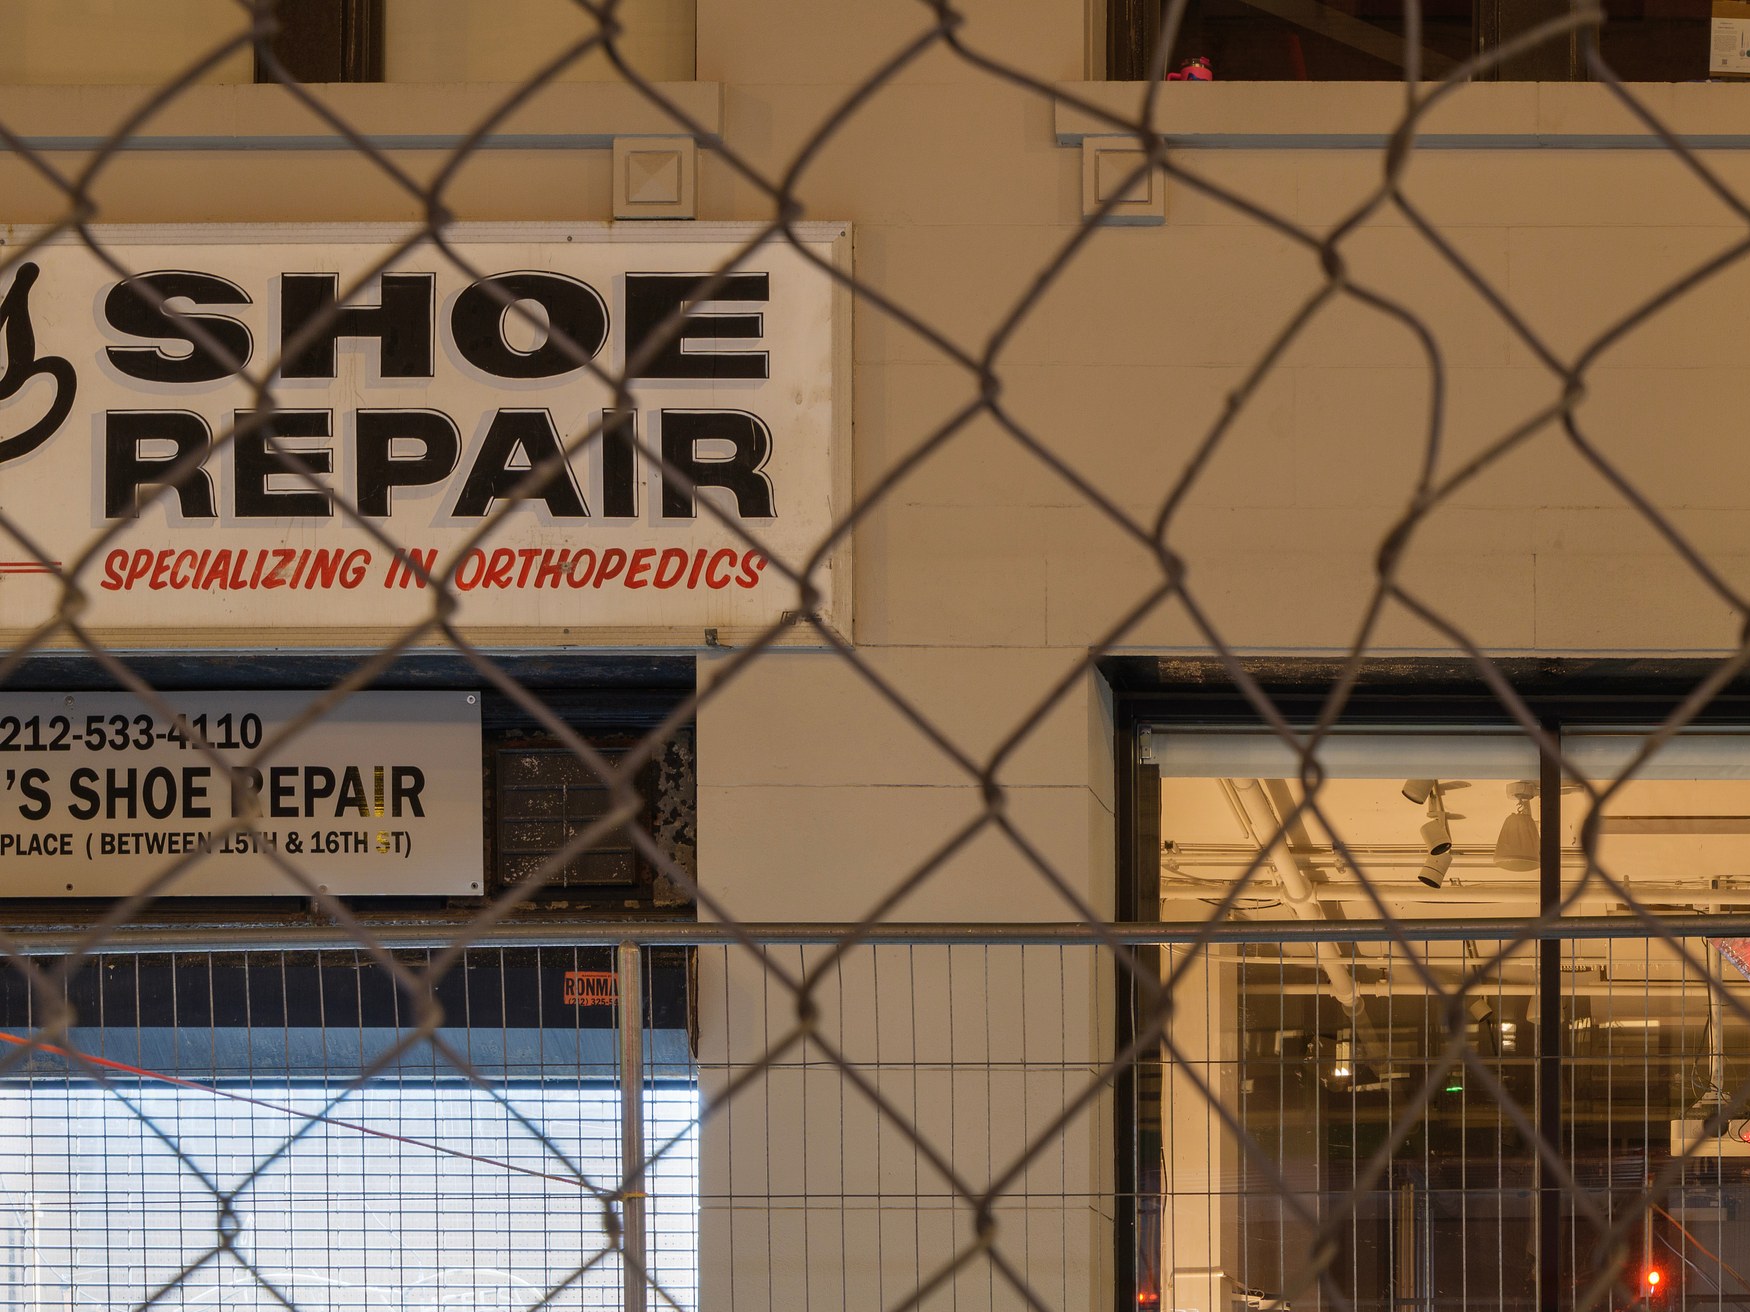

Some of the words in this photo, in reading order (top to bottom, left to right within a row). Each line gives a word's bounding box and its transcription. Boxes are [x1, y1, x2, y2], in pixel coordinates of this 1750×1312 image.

[105, 269, 770, 383] SHOE
[105, 408, 778, 518] REPAIR
[100, 548, 372, 591] SPECIALIZING
[384, 547, 439, 590] IN
[455, 547, 768, 591] ORTHOPEDICS
[0, 713, 263, 751] 212-533-4110
[68, 766, 211, 821] SHOE
[231, 765, 426, 818] REPAIR
[0, 833, 74, 856] PLACE
[284, 831, 304, 854] &
[310, 831, 369, 854] 16TH
